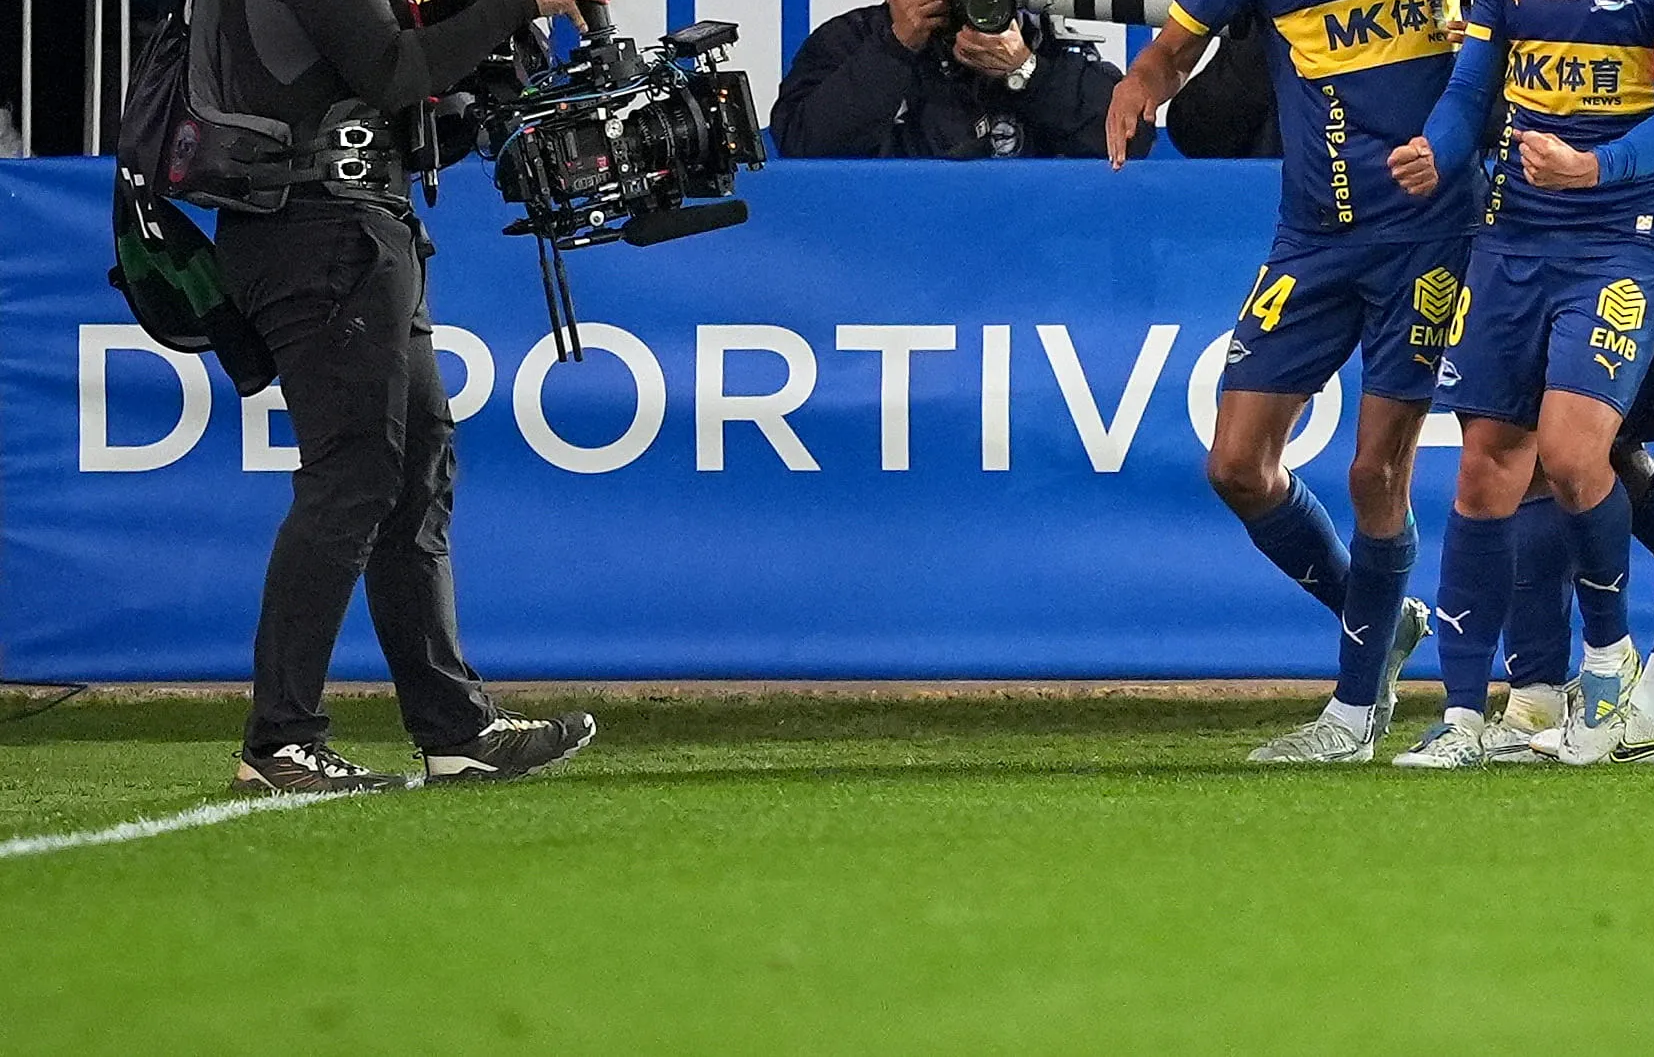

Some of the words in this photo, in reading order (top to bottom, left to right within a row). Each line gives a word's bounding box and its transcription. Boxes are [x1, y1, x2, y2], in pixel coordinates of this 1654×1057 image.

[1582, 96, 1622, 106] NEWS
[1331, 159, 1353, 224] araba
[1589, 327, 1638, 362] EMB
